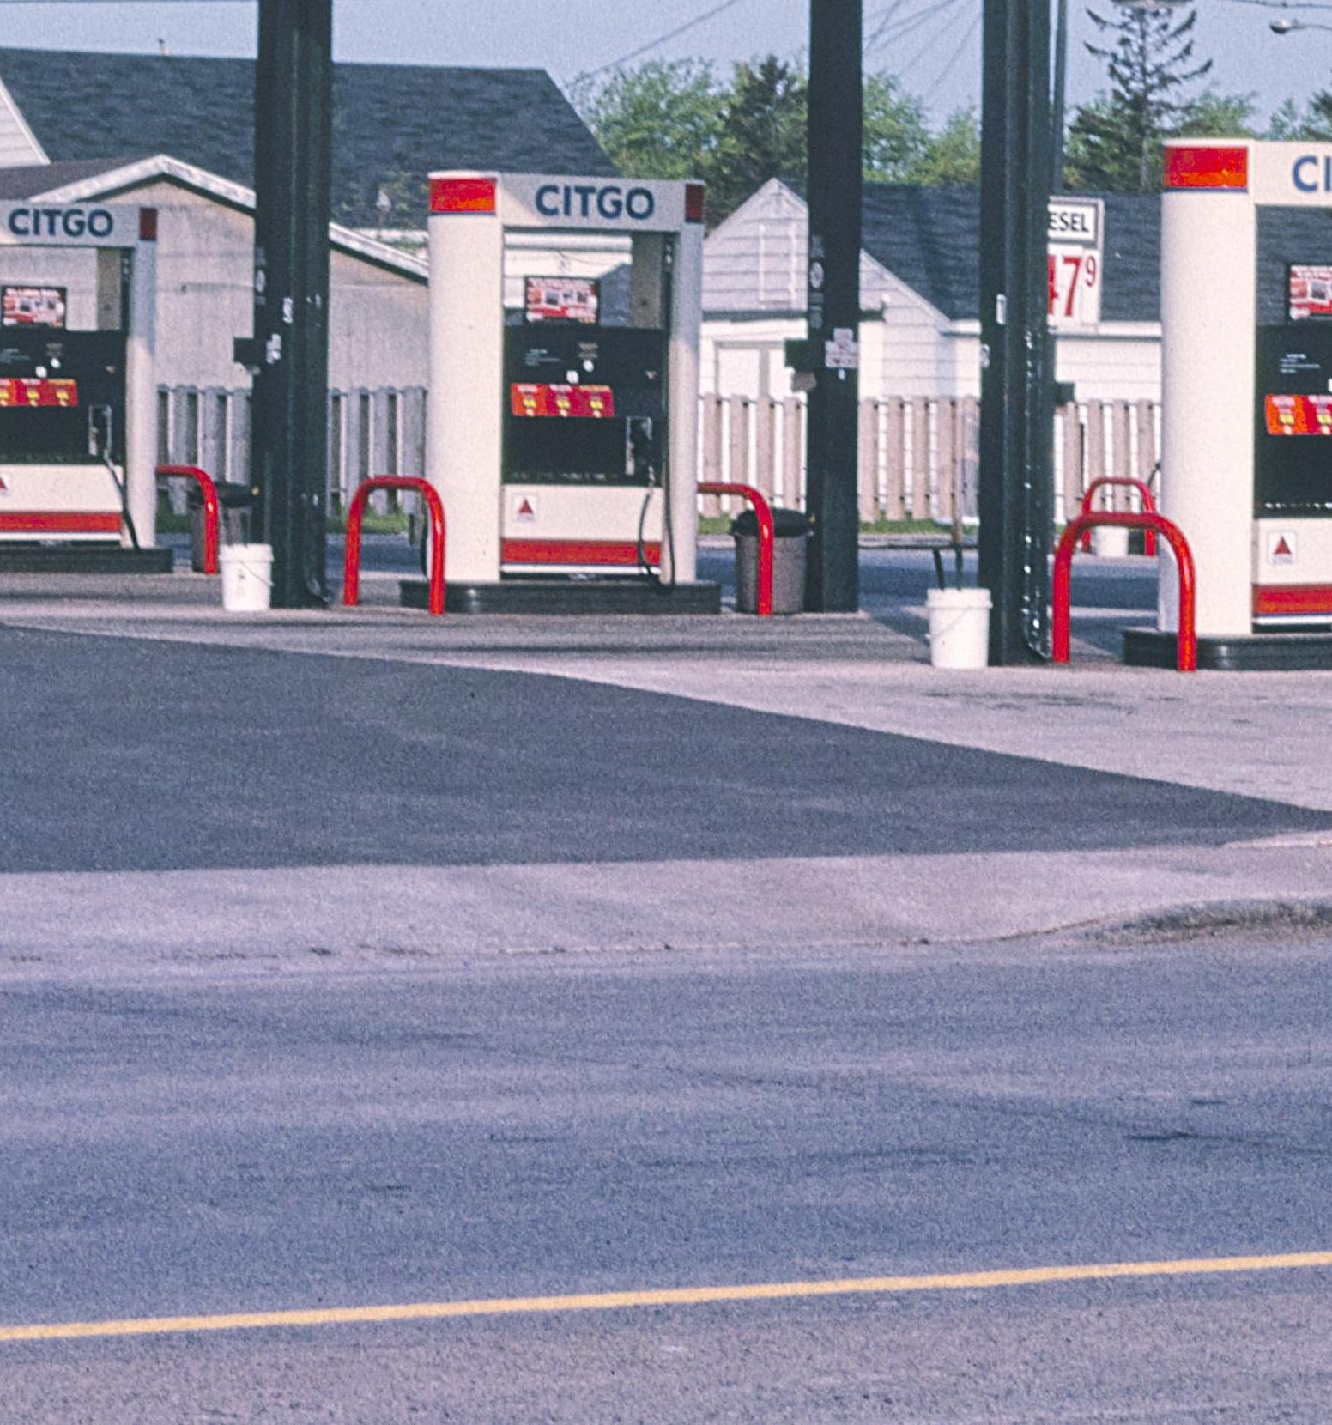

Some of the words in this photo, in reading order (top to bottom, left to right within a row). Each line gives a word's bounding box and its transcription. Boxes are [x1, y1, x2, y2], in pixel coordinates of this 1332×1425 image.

[535, 184, 654, 221] CITGO
[8, 208, 113, 238] CITGO
[1050, 212, 1090, 233] ESEL
